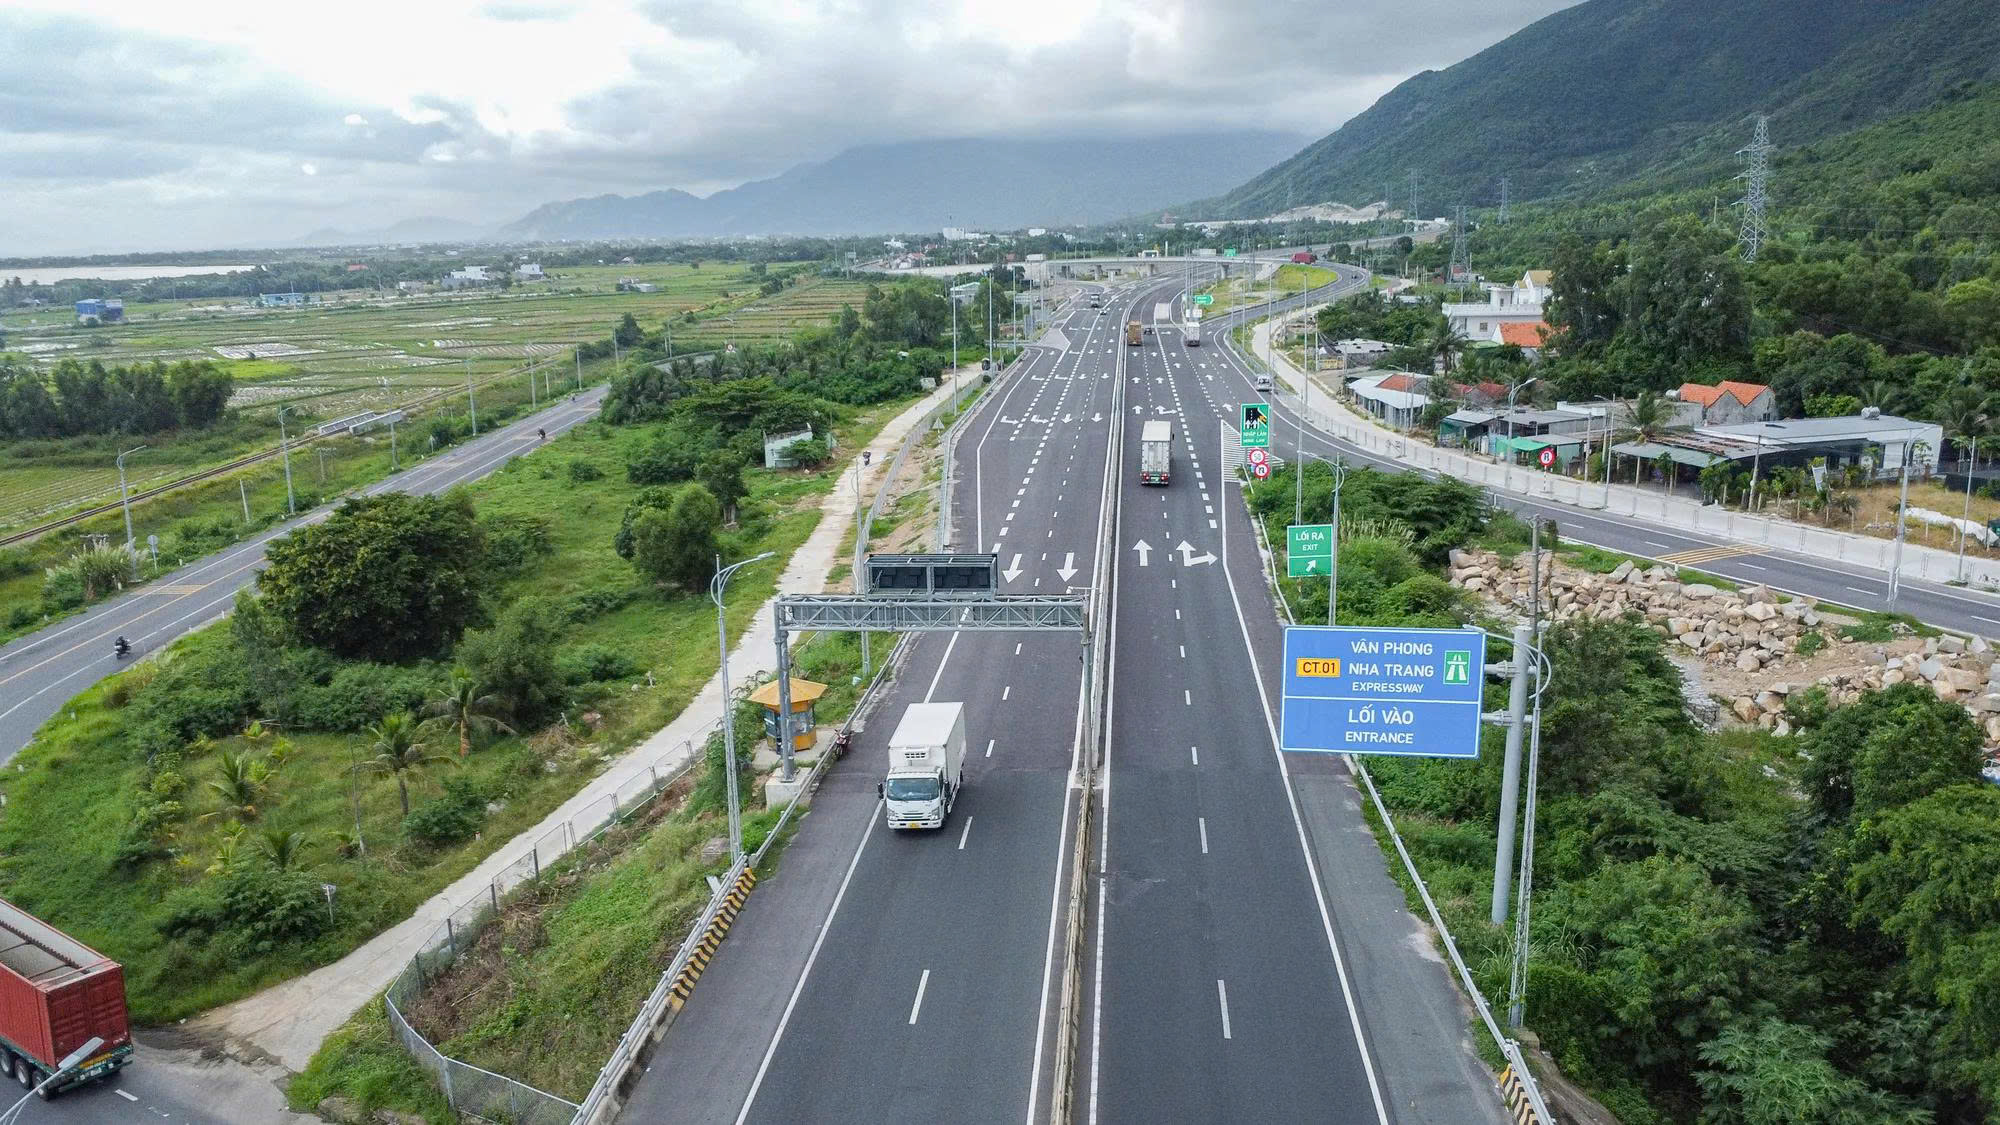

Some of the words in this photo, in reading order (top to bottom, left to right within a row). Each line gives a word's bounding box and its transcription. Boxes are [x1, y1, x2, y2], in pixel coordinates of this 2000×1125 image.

[1311, 532, 1325, 541] RA
[1351, 638, 1379, 654] VÂN
[1383, 642, 1433, 656] PHONG
[1302, 661, 1335, 674] CT.01
[1348, 662, 1380, 676] NHA
[1384, 663, 1434, 678] TRANG
[1352, 681, 1424, 693] EXPRESSWAY
[1348, 703, 1376, 724] LỐI
[1381, 706, 1414, 725] VÀO
[1345, 731, 1414, 744] ENTRANCE
